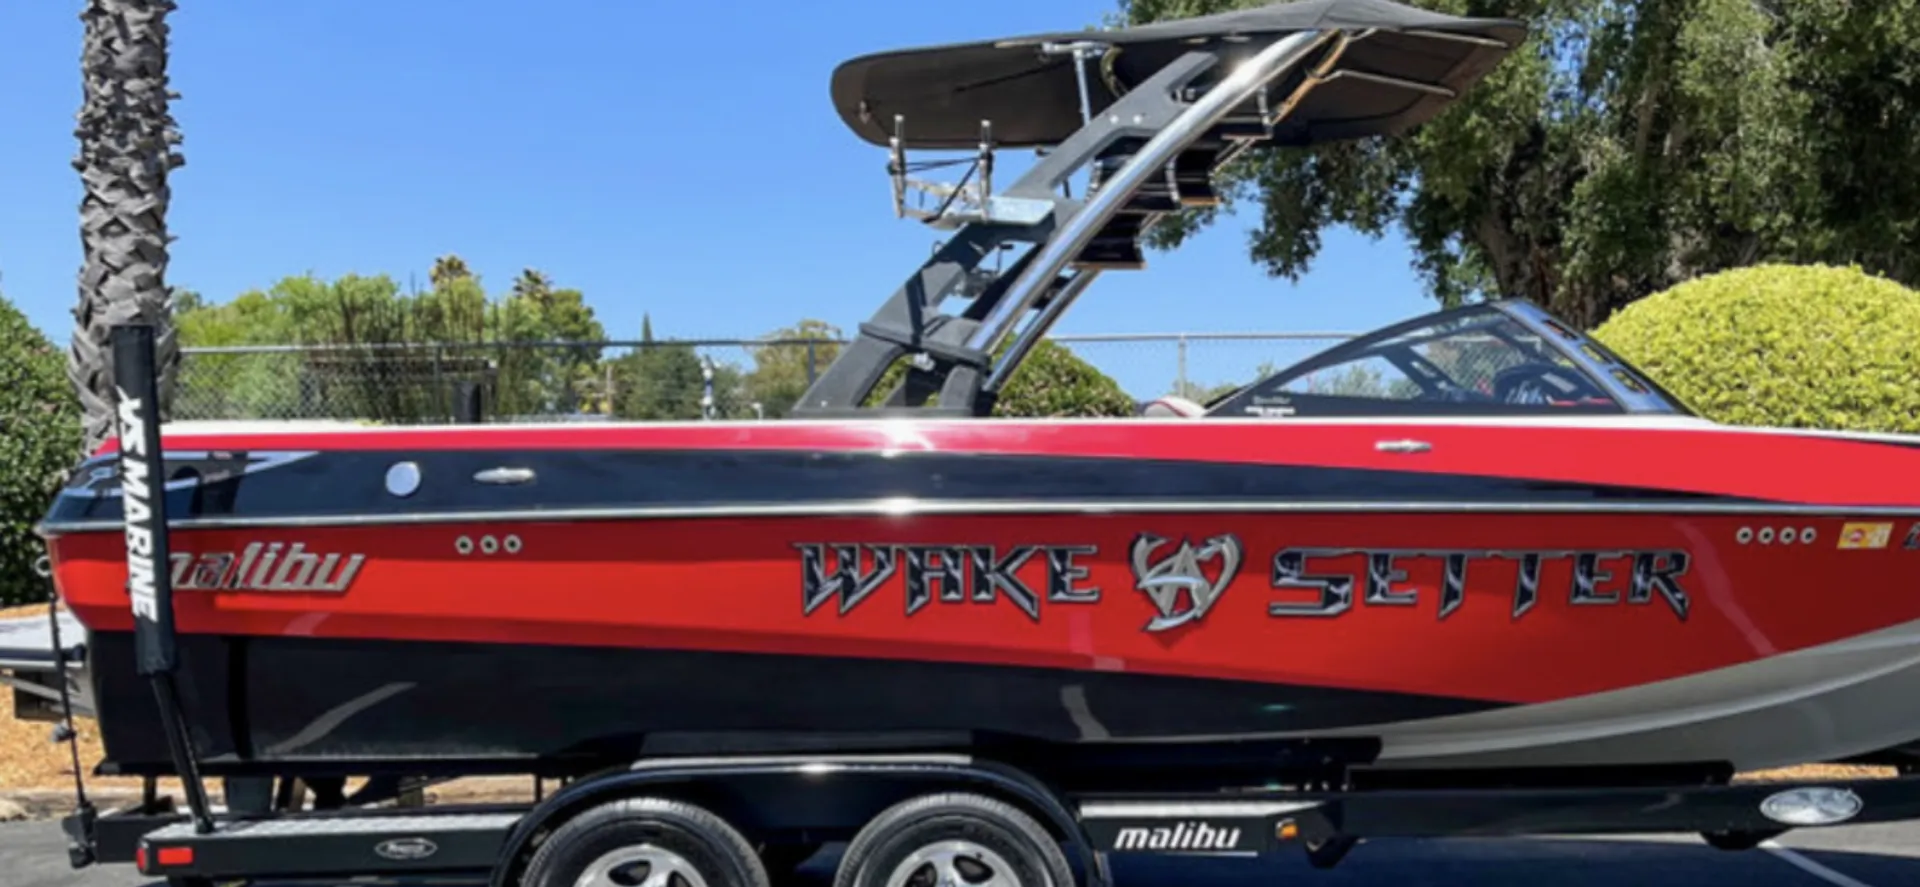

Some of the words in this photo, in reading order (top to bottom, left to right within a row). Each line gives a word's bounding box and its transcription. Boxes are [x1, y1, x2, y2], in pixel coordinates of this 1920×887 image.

[122, 456, 158, 622] MARINE
[791, 543, 1101, 623] WAKE
[1268, 546, 1692, 622] SETTER
[1114, 821, 1241, 849] malibu
